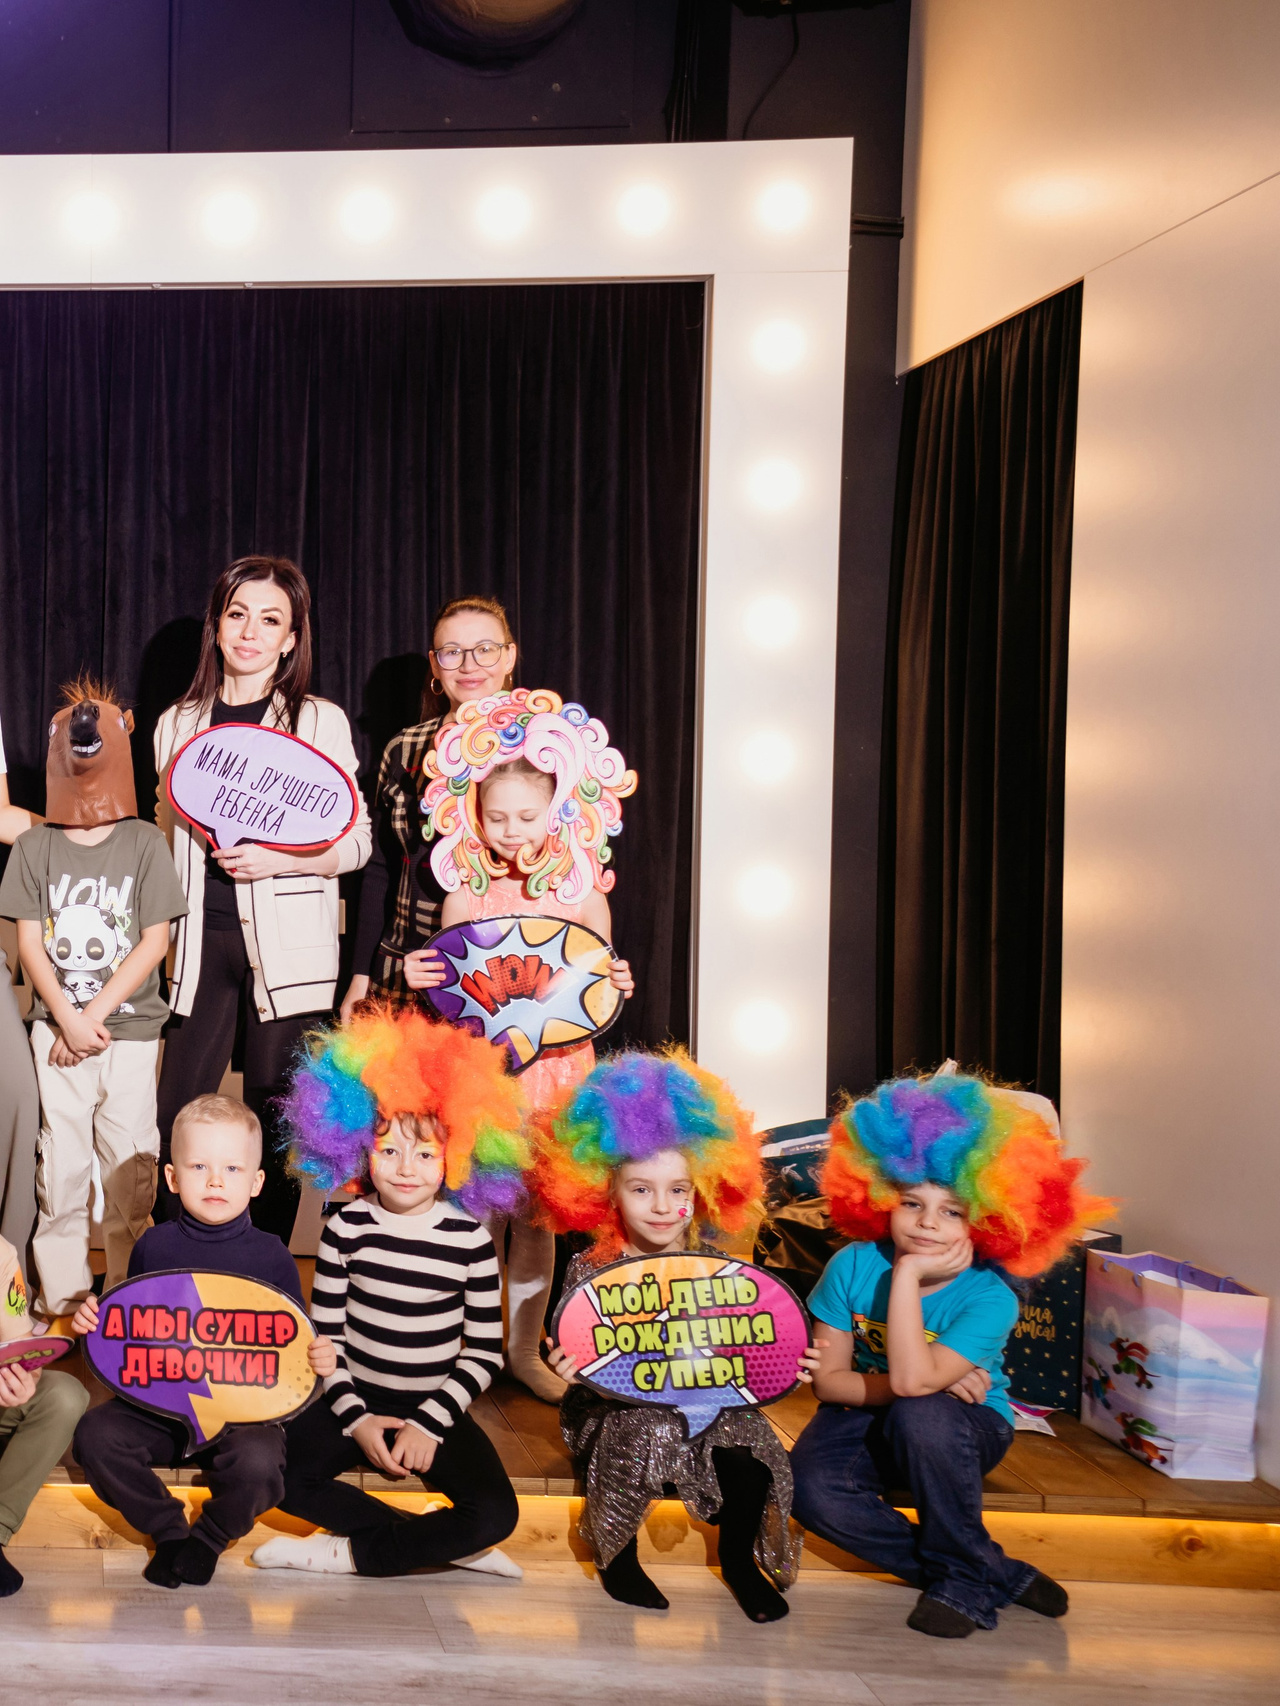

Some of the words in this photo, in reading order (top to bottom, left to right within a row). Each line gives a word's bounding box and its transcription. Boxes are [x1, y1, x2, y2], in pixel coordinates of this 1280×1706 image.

[193, 742, 249, 784] МАМА
[250, 766, 339, 818] ЛУЧШЕГО
[210, 784, 287, 836] РЕБЕНКА
[460, 953, 570, 1018] WOW
[598, 1273, 662, 1316] МОЙ
[668, 1274, 759, 1318] ДЕНЬ
[102, 1304, 128, 1340] А
[130, 1305, 190, 1343] МЫ
[193, 1307, 298, 1348] СУПЕР
[592, 1312, 776, 1358] РОЖДЕНИЯ
[119, 1344, 280, 1389] ДЕВОЧКИ!
[632, 1354, 747, 1393] СУПЕР!
